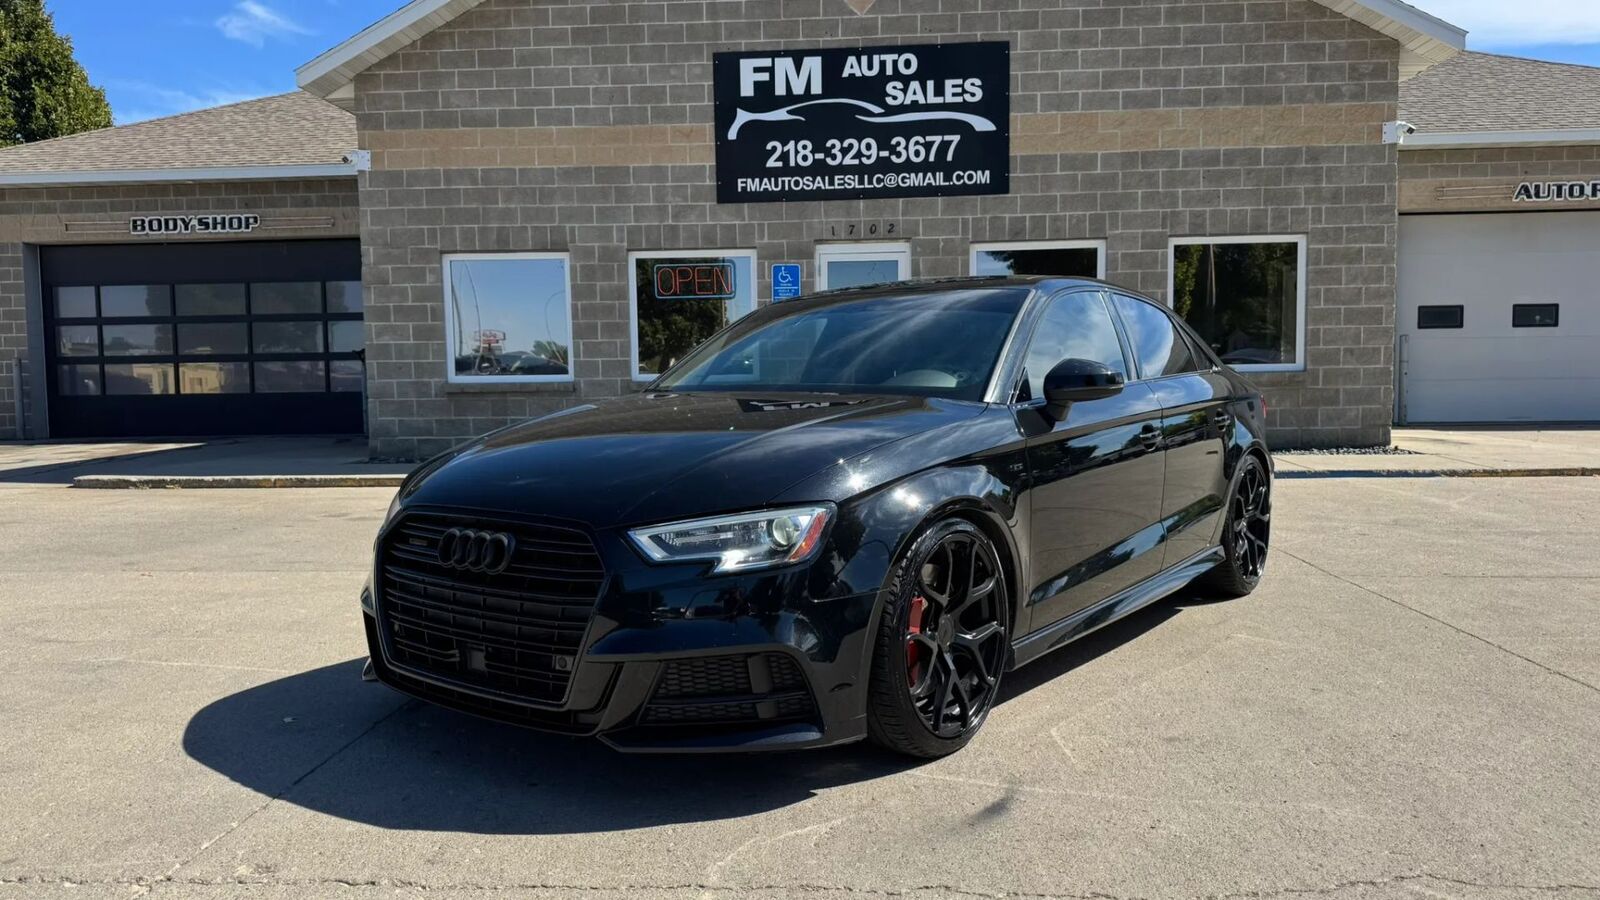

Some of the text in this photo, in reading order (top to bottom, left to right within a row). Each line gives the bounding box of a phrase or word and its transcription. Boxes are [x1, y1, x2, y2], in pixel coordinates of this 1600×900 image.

[739, 53, 918, 97] FM AUTO
[885, 78, 983, 106] SALES
[765, 135, 961, 168] 218-329-3677
[737, 170, 990, 192] FMAUTOSALESLLC@GMAIL.COM
[1512, 181, 1586, 202] AUTO
[131, 214, 259, 235] BODY SHOP
[831, 223, 895, 236] 1702
[657, 267, 733, 296] OPEN
